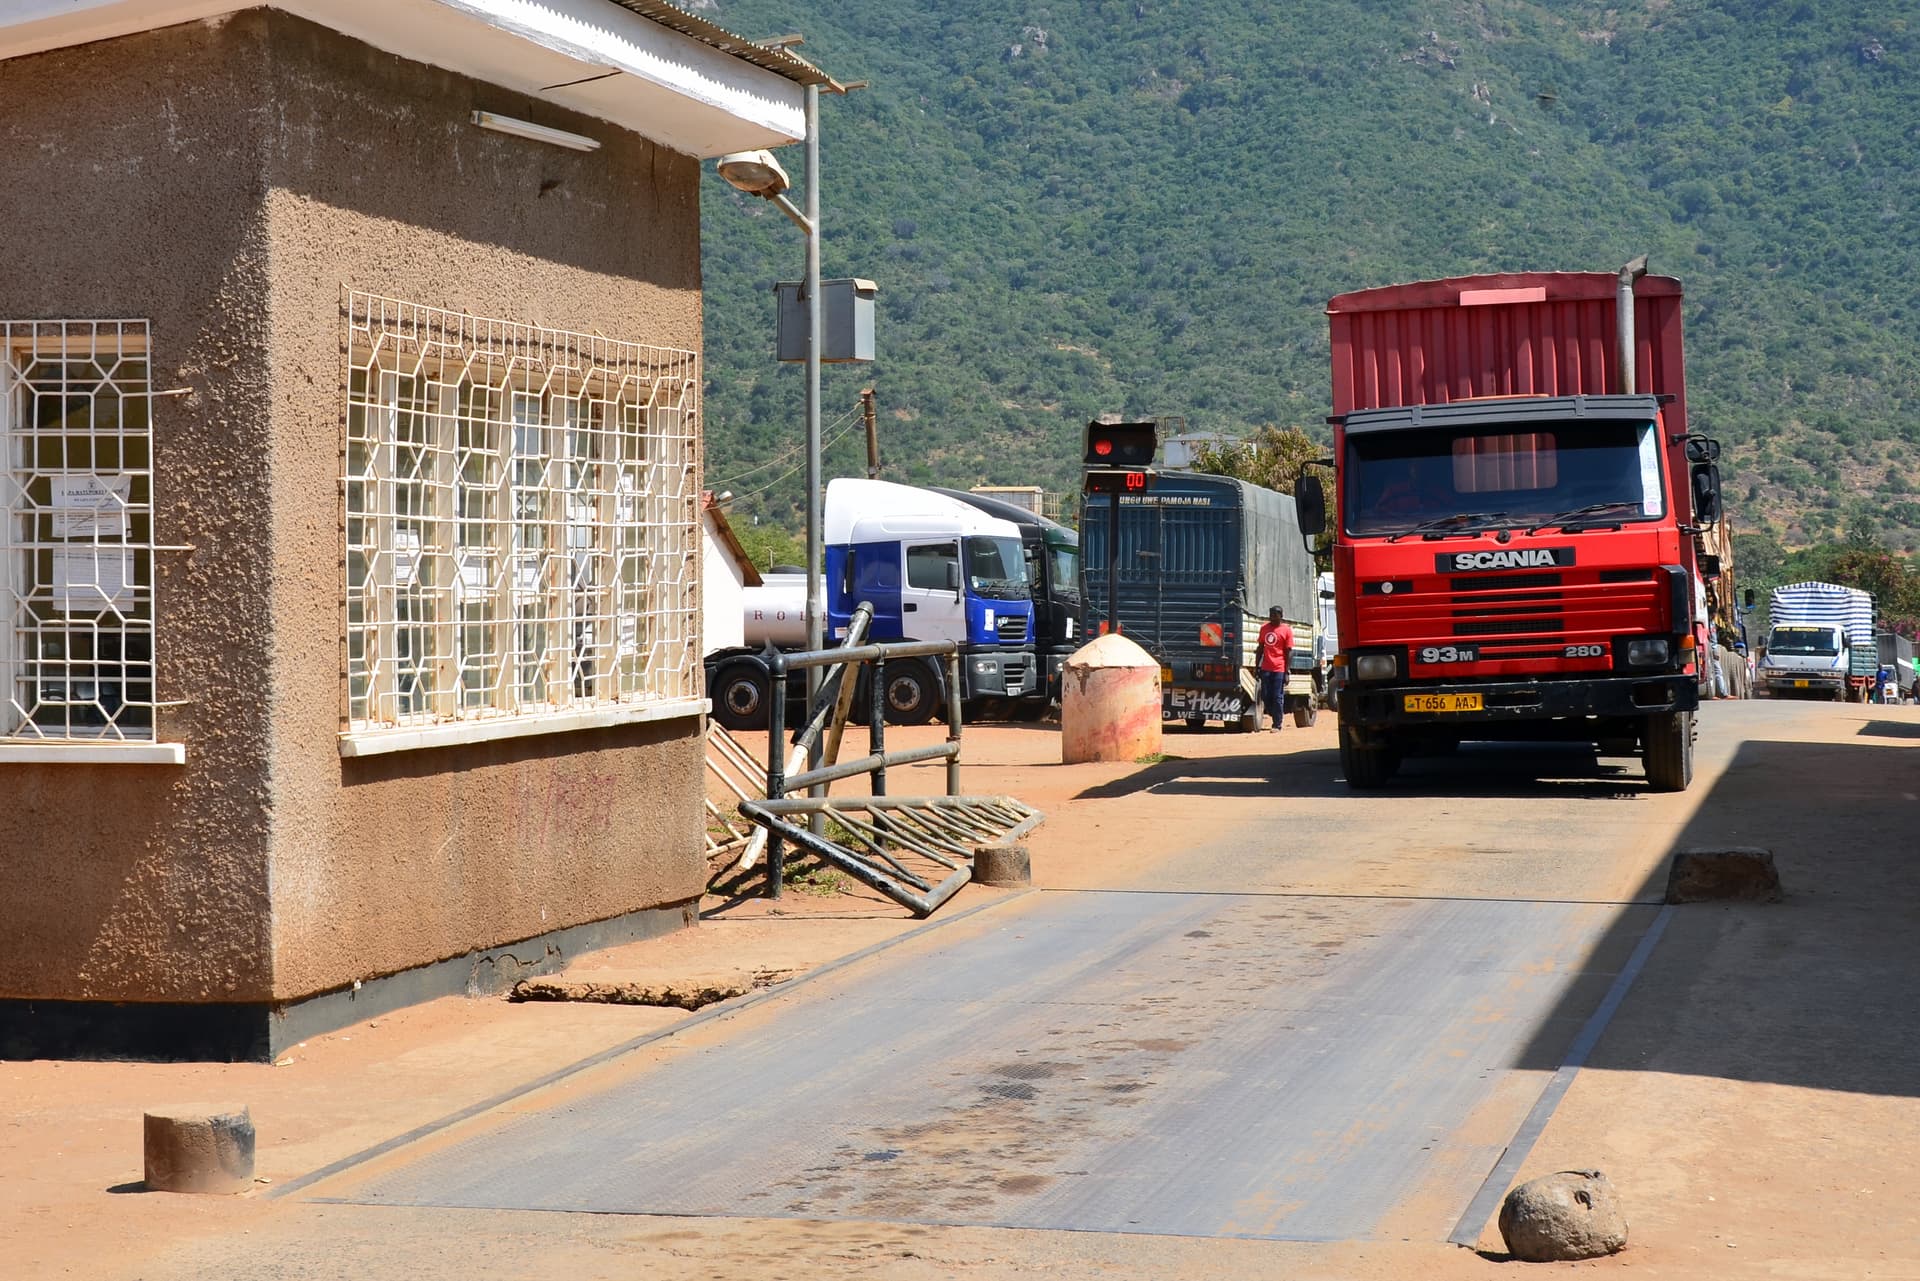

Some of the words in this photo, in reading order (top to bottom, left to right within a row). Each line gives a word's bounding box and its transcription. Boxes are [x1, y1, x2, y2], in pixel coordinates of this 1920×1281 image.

[1126, 472, 1144, 488] 00
[1119, 496, 1141, 504] UNGU
[1161, 496, 1191, 505] PAMOJA
[1455, 549, 1556, 570] SCANIA
[1566, 645, 1602, 658] 280
[1186, 689, 1242, 713] Horse
[1425, 697, 1446, 710] 656
[1455, 696, 1477, 710] AAJ
[1177, 711, 1196, 720] WE
